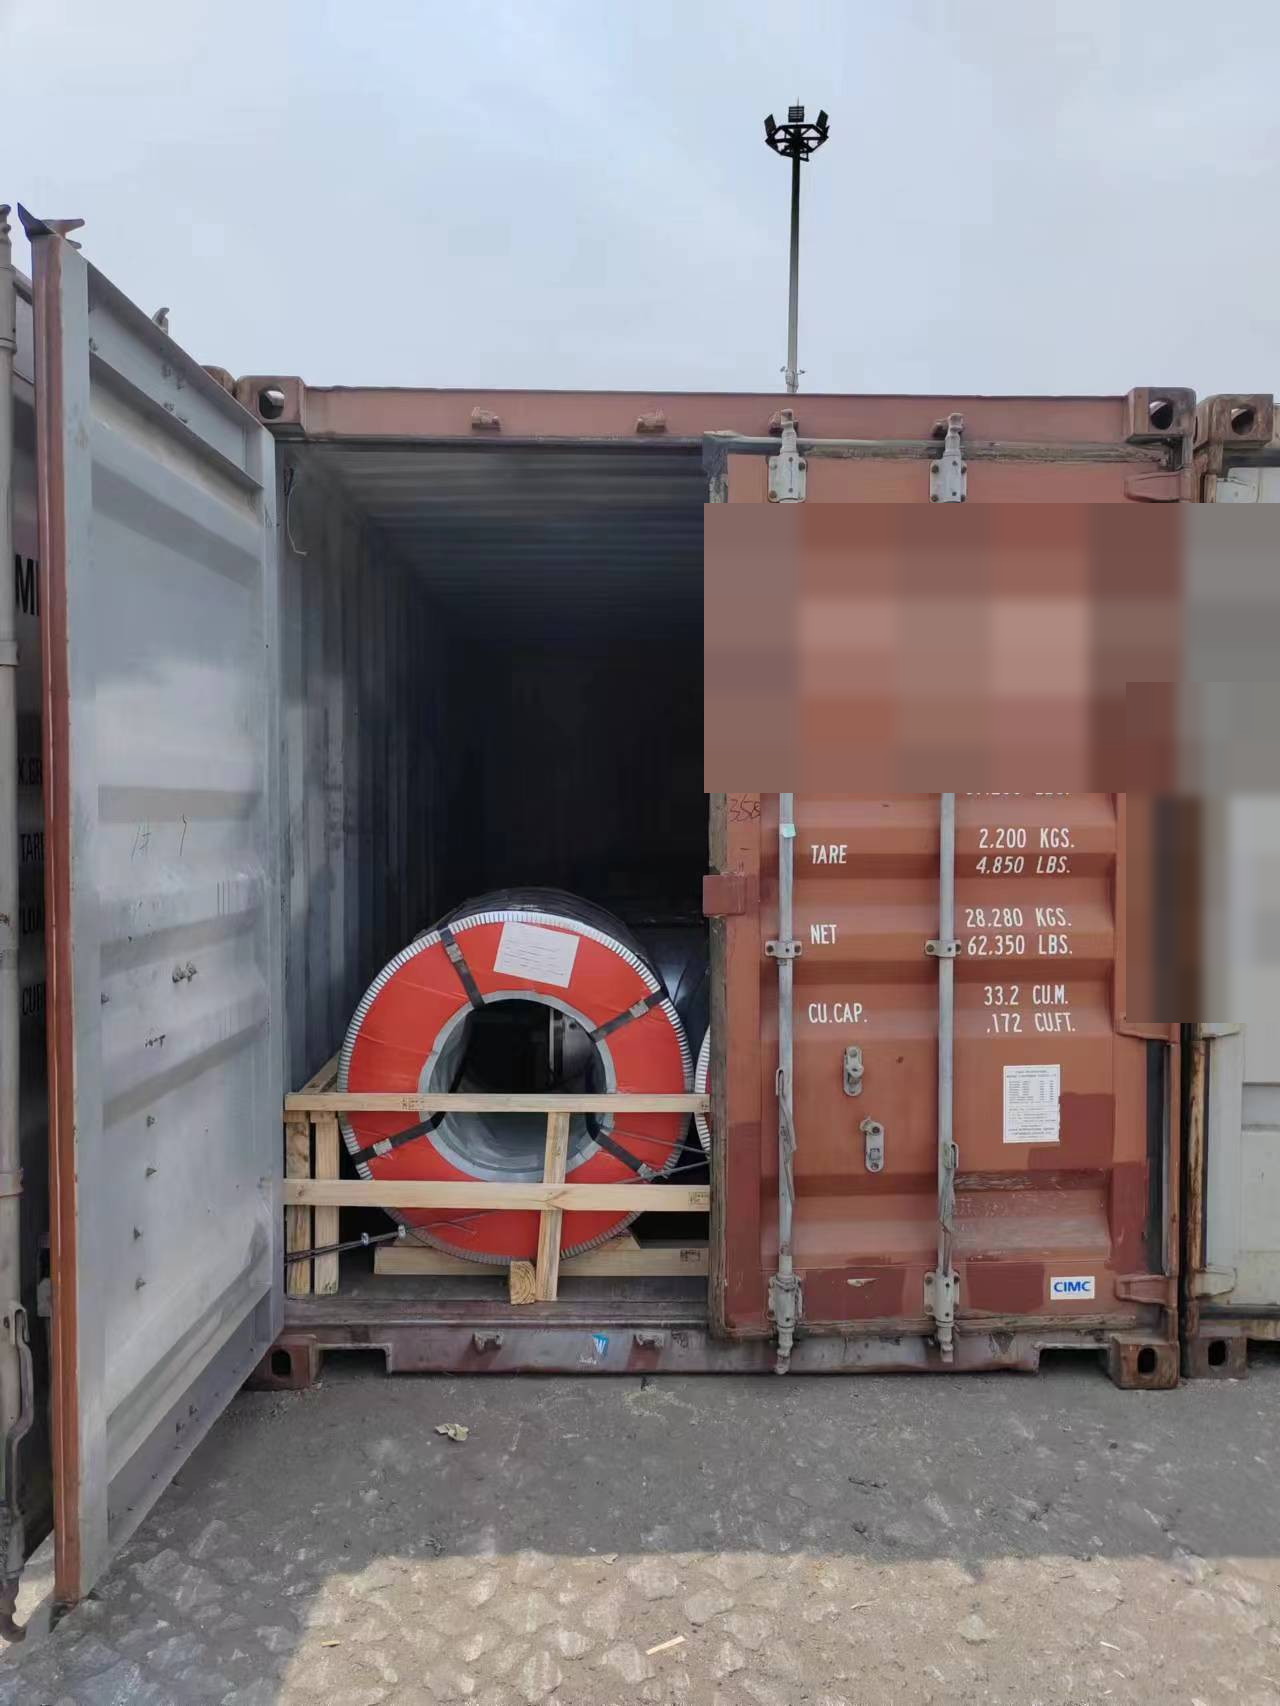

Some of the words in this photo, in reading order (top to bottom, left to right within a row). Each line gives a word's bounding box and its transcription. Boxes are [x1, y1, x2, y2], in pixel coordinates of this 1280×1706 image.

[1039, 827, 1075, 849] KGS.
[810, 844, 848, 864] TARE
[1036, 855, 1071, 874] LBS.
[1035, 907, 1072, 927] KGS.
[810, 924, 837, 945] NET
[1038, 934, 1073, 955] LBS.
[983, 985, 1019, 1006] 33.2
[1032, 984, 1069, 1005] CU.M.
[808, 1002, 868, 1024] CU.CAP.
[1053, 1280, 1092, 1293] CIMC
